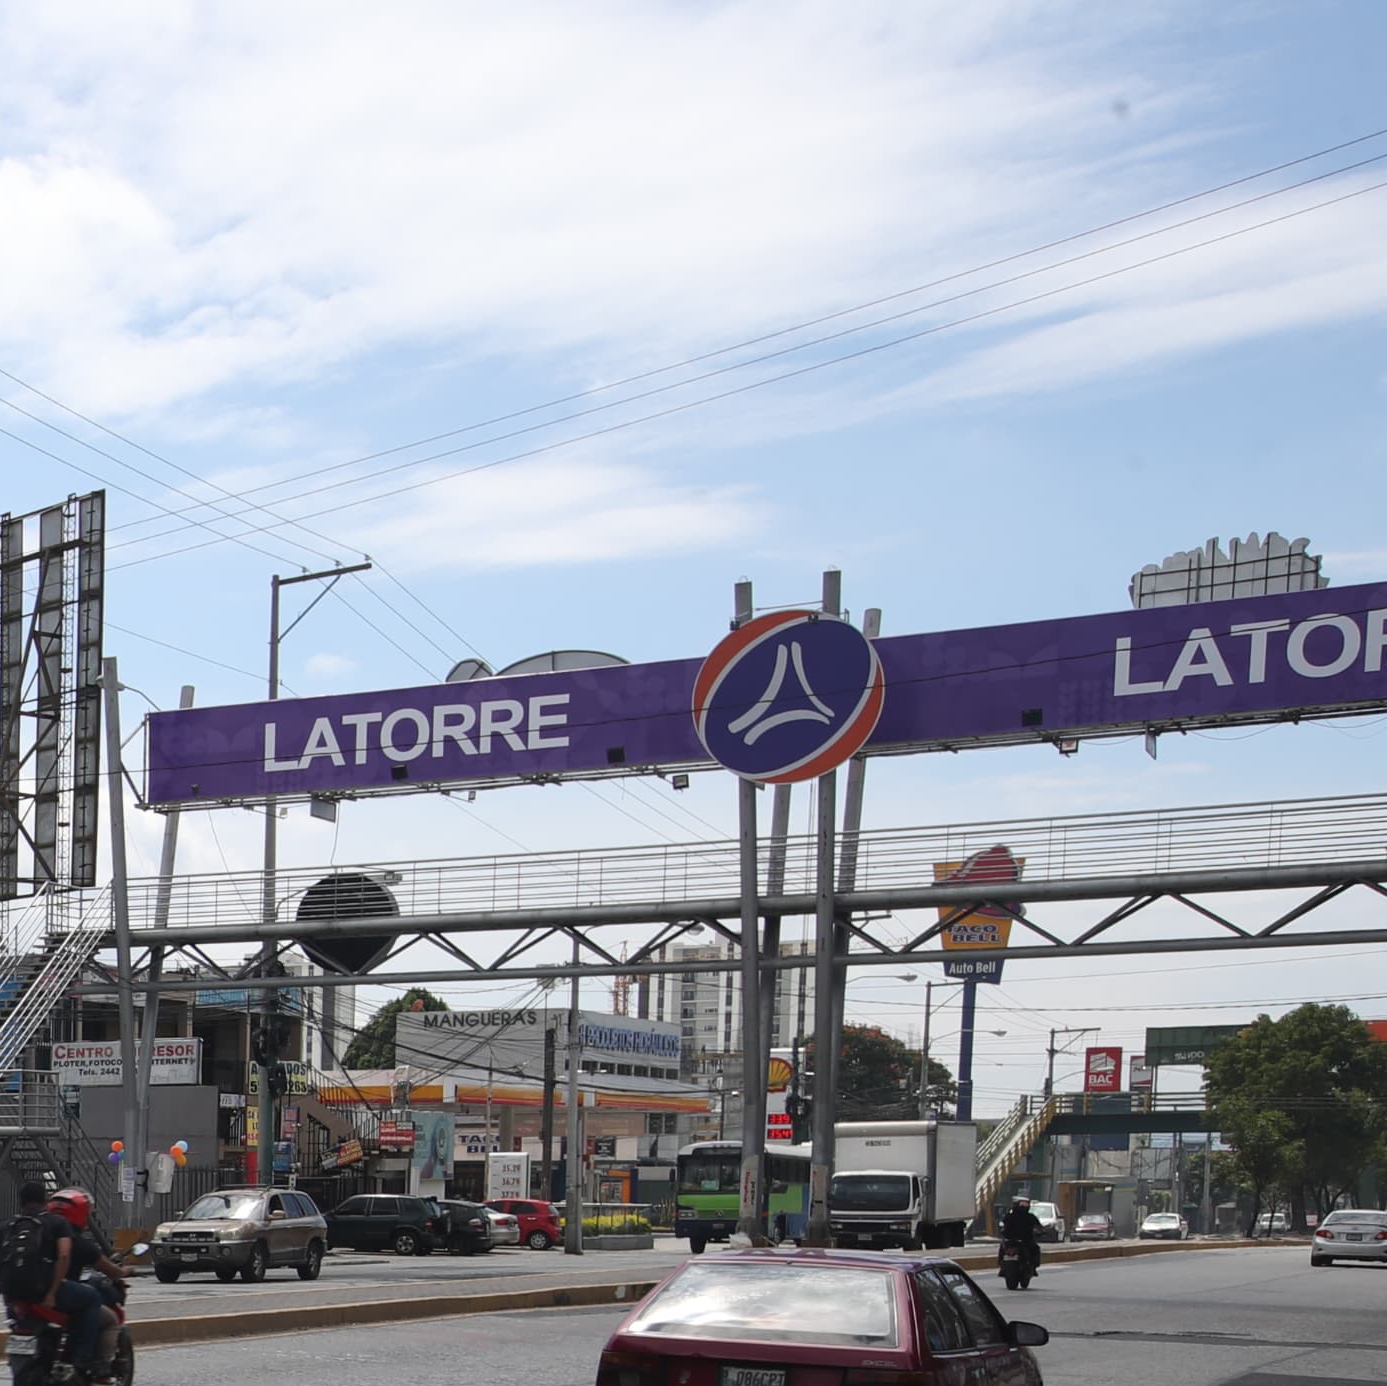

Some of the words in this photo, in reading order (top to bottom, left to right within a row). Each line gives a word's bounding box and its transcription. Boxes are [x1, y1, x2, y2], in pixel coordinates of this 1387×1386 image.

[263, 693, 570, 773] LATORRE
[953, 934, 1002, 943] BELL
[949, 962, 974, 974] Auto
[976, 961, 995, 974] Bell
[423, 1011, 538, 1028] MANGUERAS
[54, 1045, 114, 1060] CENTRO
[1088, 1074, 1114, 1084] BAC
